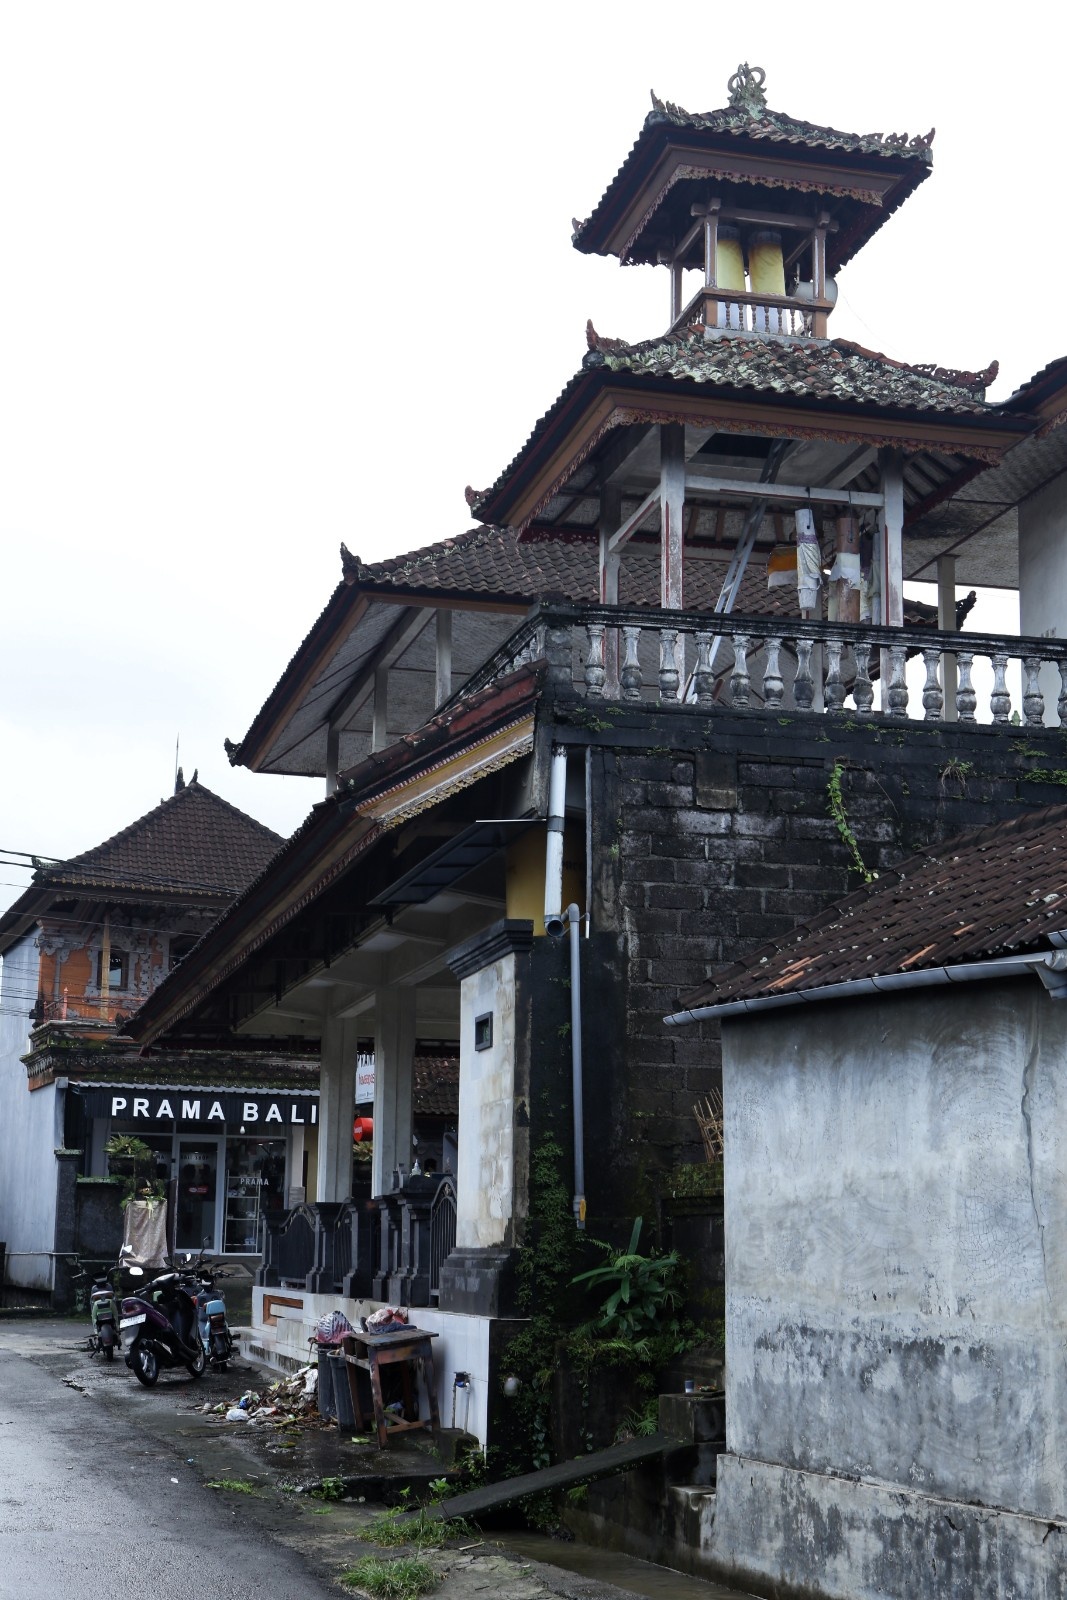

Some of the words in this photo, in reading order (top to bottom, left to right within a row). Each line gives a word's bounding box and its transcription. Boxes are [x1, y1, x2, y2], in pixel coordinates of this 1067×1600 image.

[111, 1097, 225, 1120] PRAMA
[243, 1103, 317, 1124] BALI
[240, 1178, 269, 1186] PRAMA
